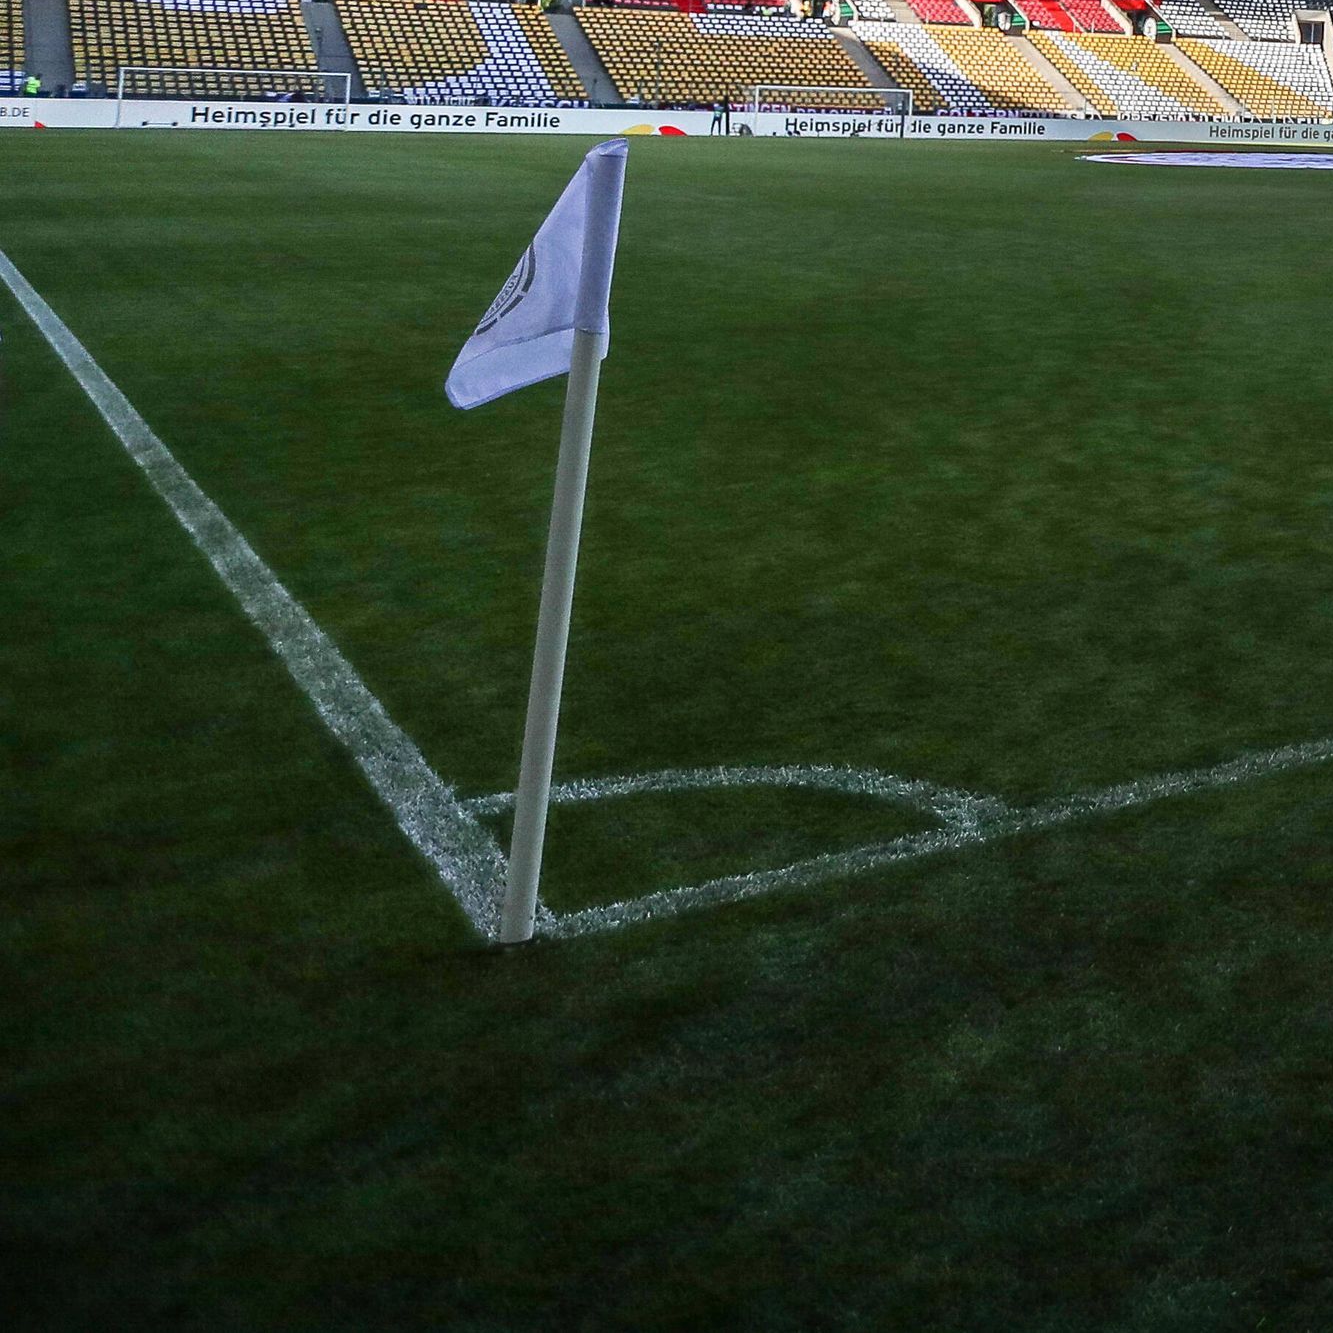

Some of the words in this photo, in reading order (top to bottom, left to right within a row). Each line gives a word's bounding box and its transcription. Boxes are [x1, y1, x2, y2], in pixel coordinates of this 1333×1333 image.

[191, 106, 316, 129] Heimspiel
[325, 108, 360, 125] für
[368, 109, 402, 126] die
[410, 113, 477, 130] ganze
[485, 111, 560, 128] Familie
[784, 116, 871, 137] Heimspiel
[876, 118, 904, 134] für
[936, 122, 986, 138] ganze
[990, 120, 1046, 136] Familie
[1208, 125, 1275, 141] Heimspiel
[1278, 126, 1298, 140] für
[1301, 127, 1320, 141] die
